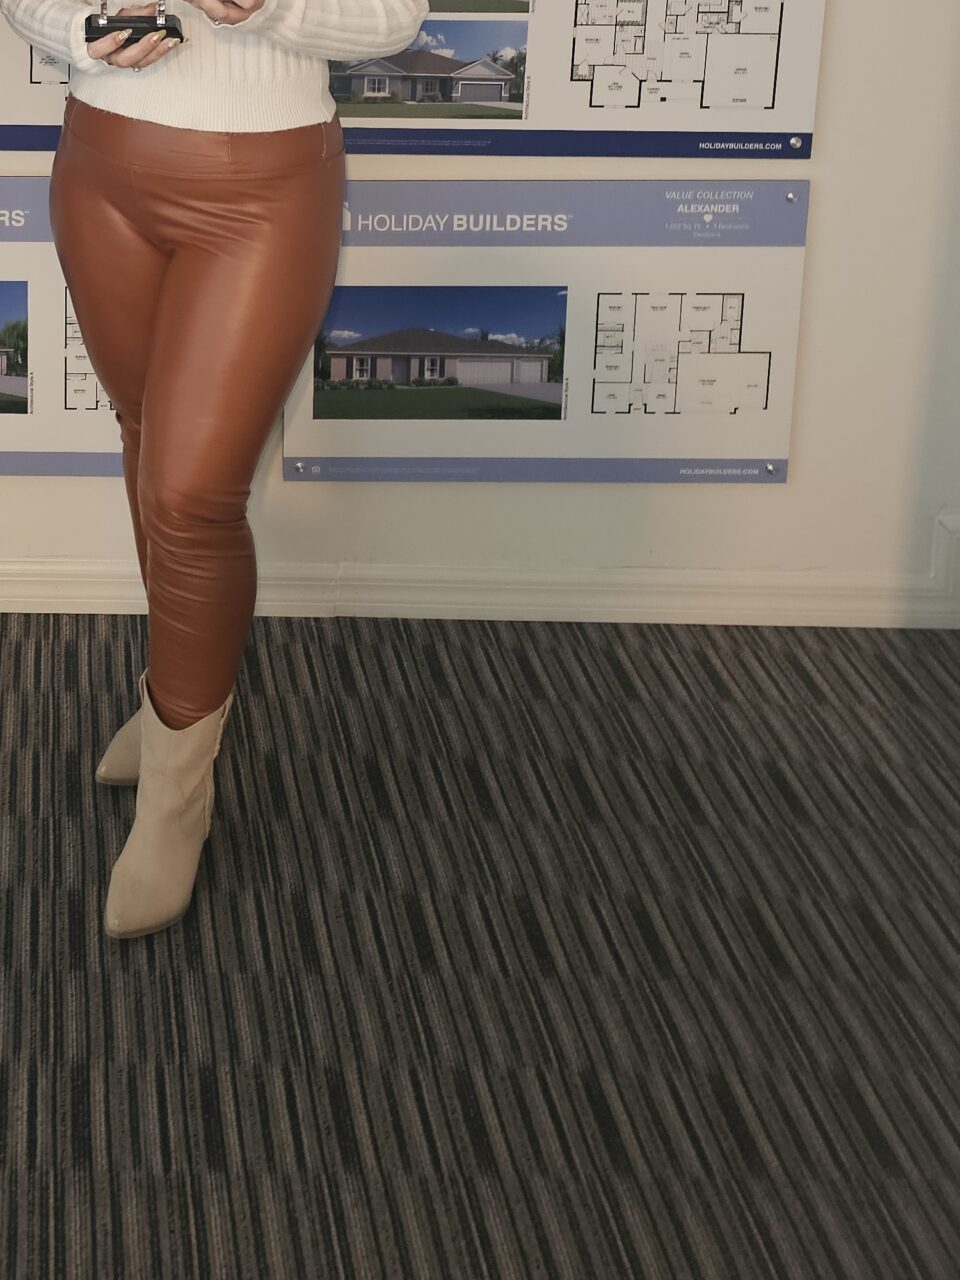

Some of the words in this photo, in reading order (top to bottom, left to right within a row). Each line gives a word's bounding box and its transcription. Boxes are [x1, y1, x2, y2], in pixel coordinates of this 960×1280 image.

[700, 142, 782, 150] HOLIDAYBUILDERS.COM
[666, 191, 694, 200] VALUE
[696, 191, 754, 200] COLLECTION
[677, 204, 740, 213] ALEXANDER
[358, 214, 449, 232] HOLIDAY
[453, 214, 568, 232] BUILDERS
[680, 468, 759, 476] HOLIDAYBUILDERS.COM
